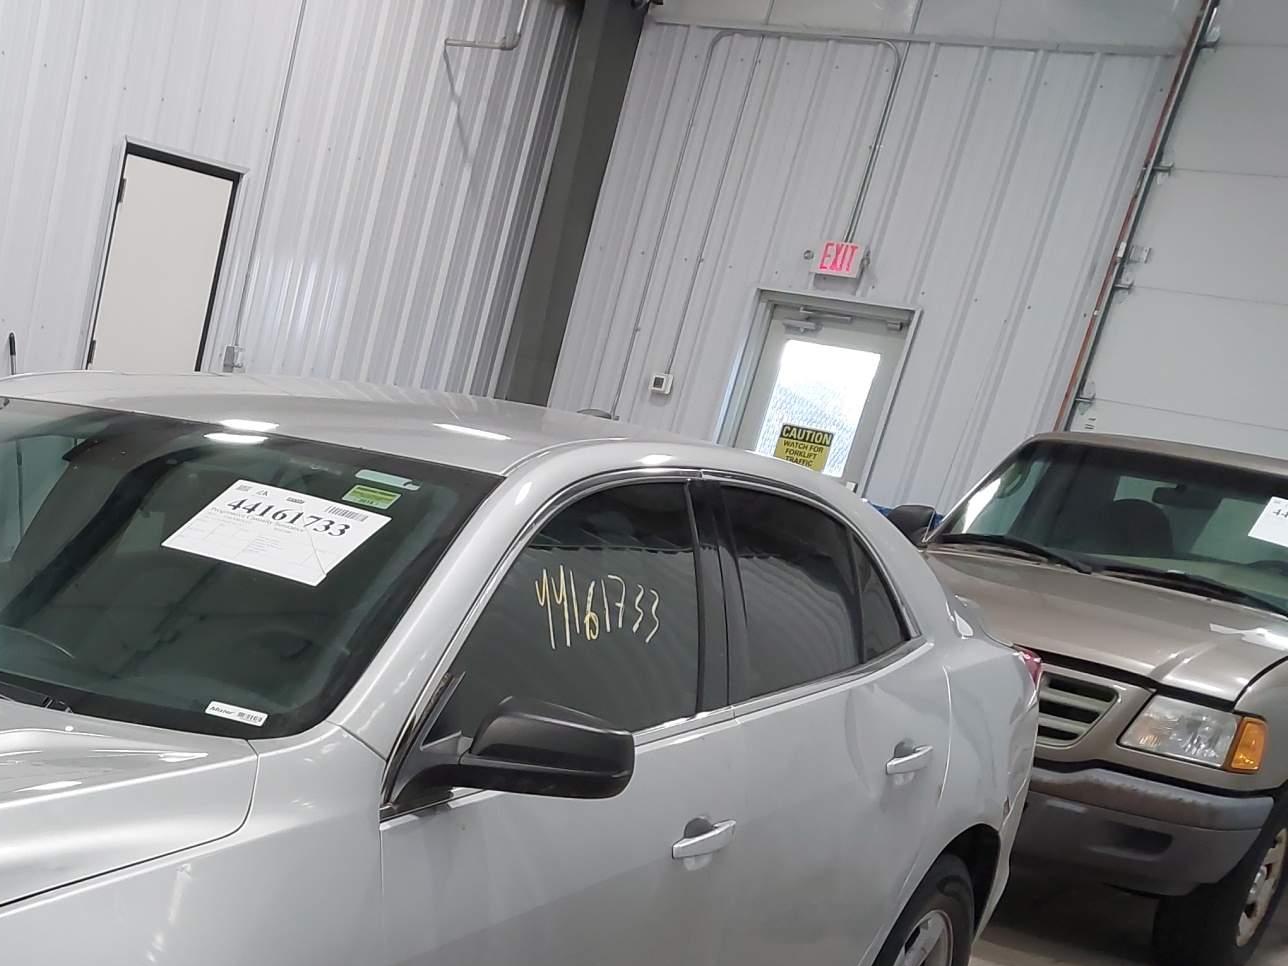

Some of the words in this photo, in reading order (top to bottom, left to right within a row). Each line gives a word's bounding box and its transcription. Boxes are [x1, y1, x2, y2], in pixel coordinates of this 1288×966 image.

[819, 242, 858, 272] EXIT
[782, 425, 832, 446] CAUTION
[783, 440, 808, 451] WATCH
[809, 444, 824, 454] FOR
[785, 447, 818, 460] FORKLIFT
[227, 498, 351, 537] 44161733
